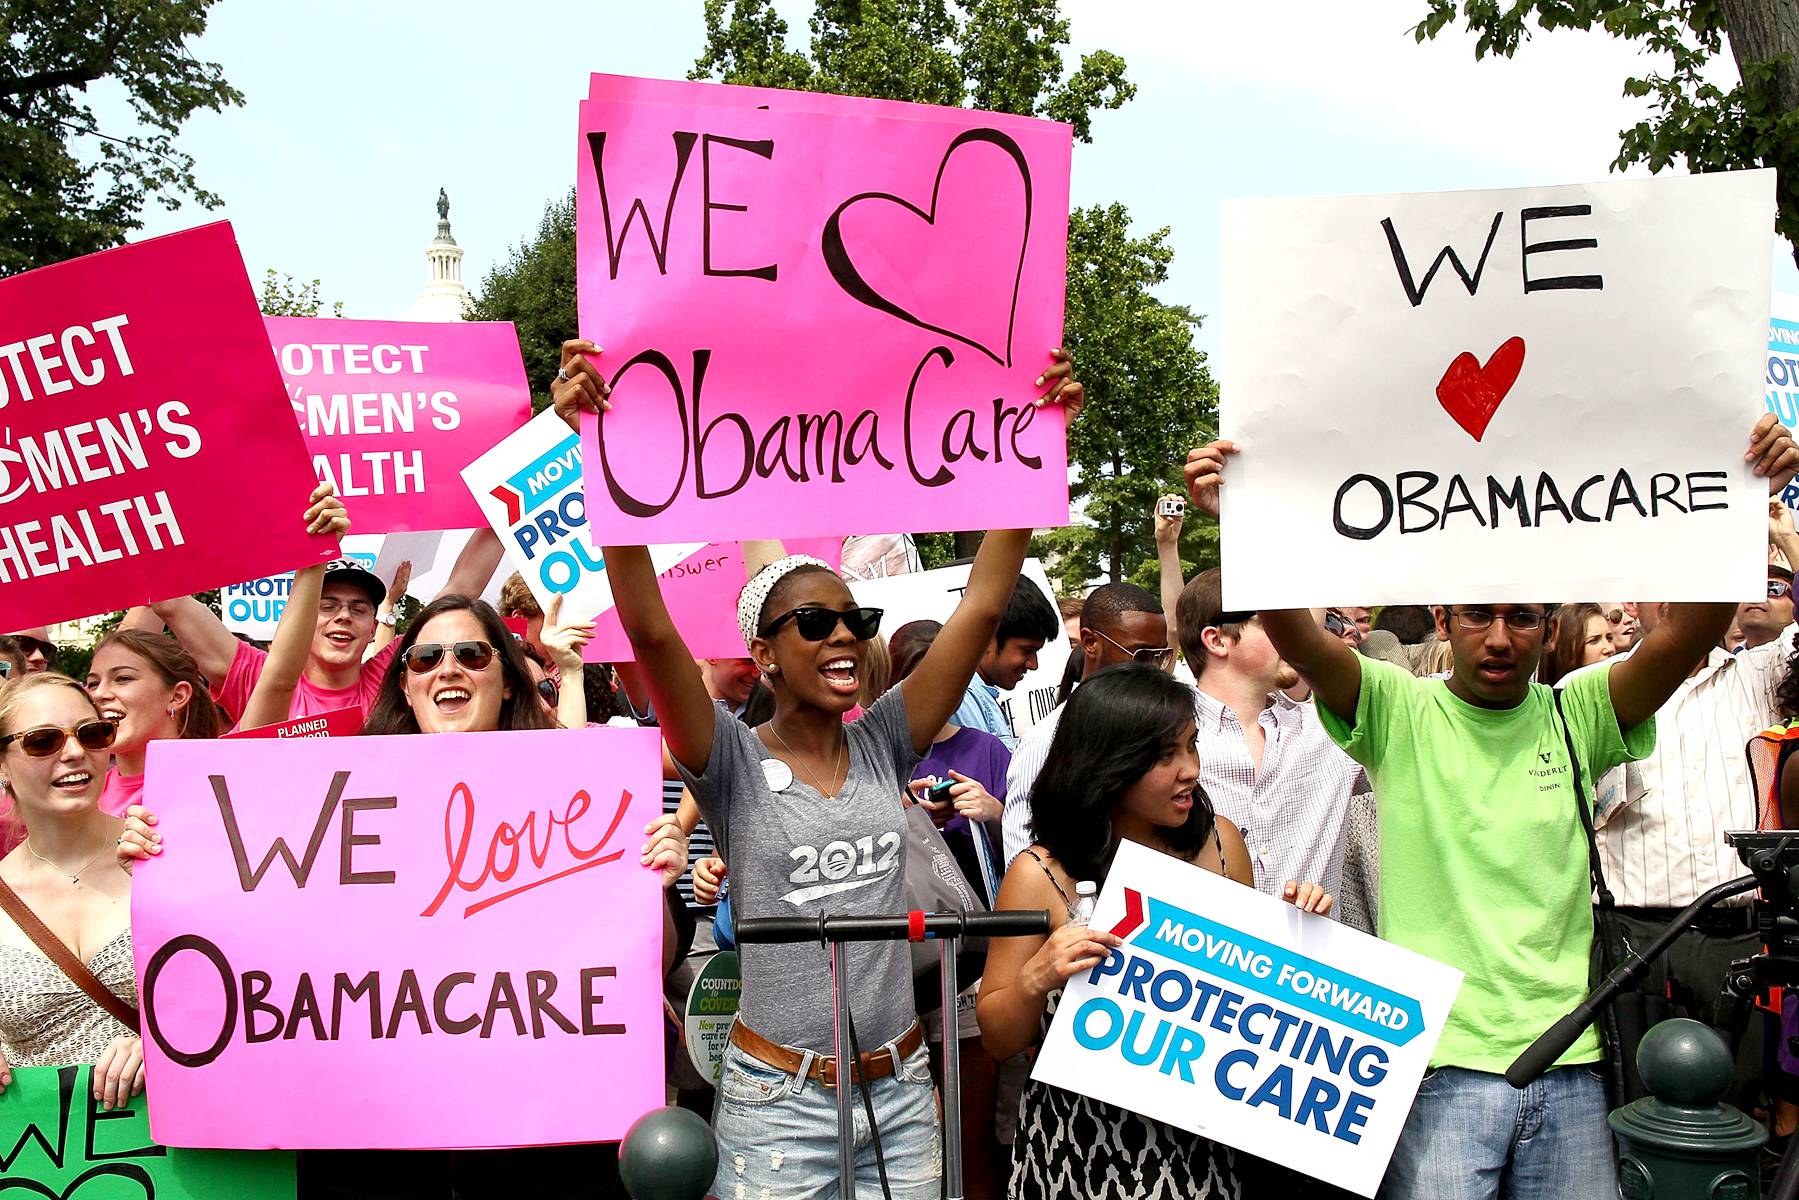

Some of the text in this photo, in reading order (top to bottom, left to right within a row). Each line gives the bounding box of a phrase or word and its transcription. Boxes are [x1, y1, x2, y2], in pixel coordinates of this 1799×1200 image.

[587, 131, 777, 281] WE
[1380, 204, 1603, 307] WE
[272, 343, 429, 376] OTECT
[1333, 467, 1729, 540] OBAMACARE
[277, 718, 328, 738] PLANNED
[208, 771, 633, 917] WE love
[789, 832, 901, 883] 2012
[143, 933, 627, 1068] OBAMACARE
[1088, 948, 1390, 1088] PROTECTING
[1156, 918, 1410, 1032] MOVING FORWARD
[1072, 997, 1377, 1146] OUR CARE
